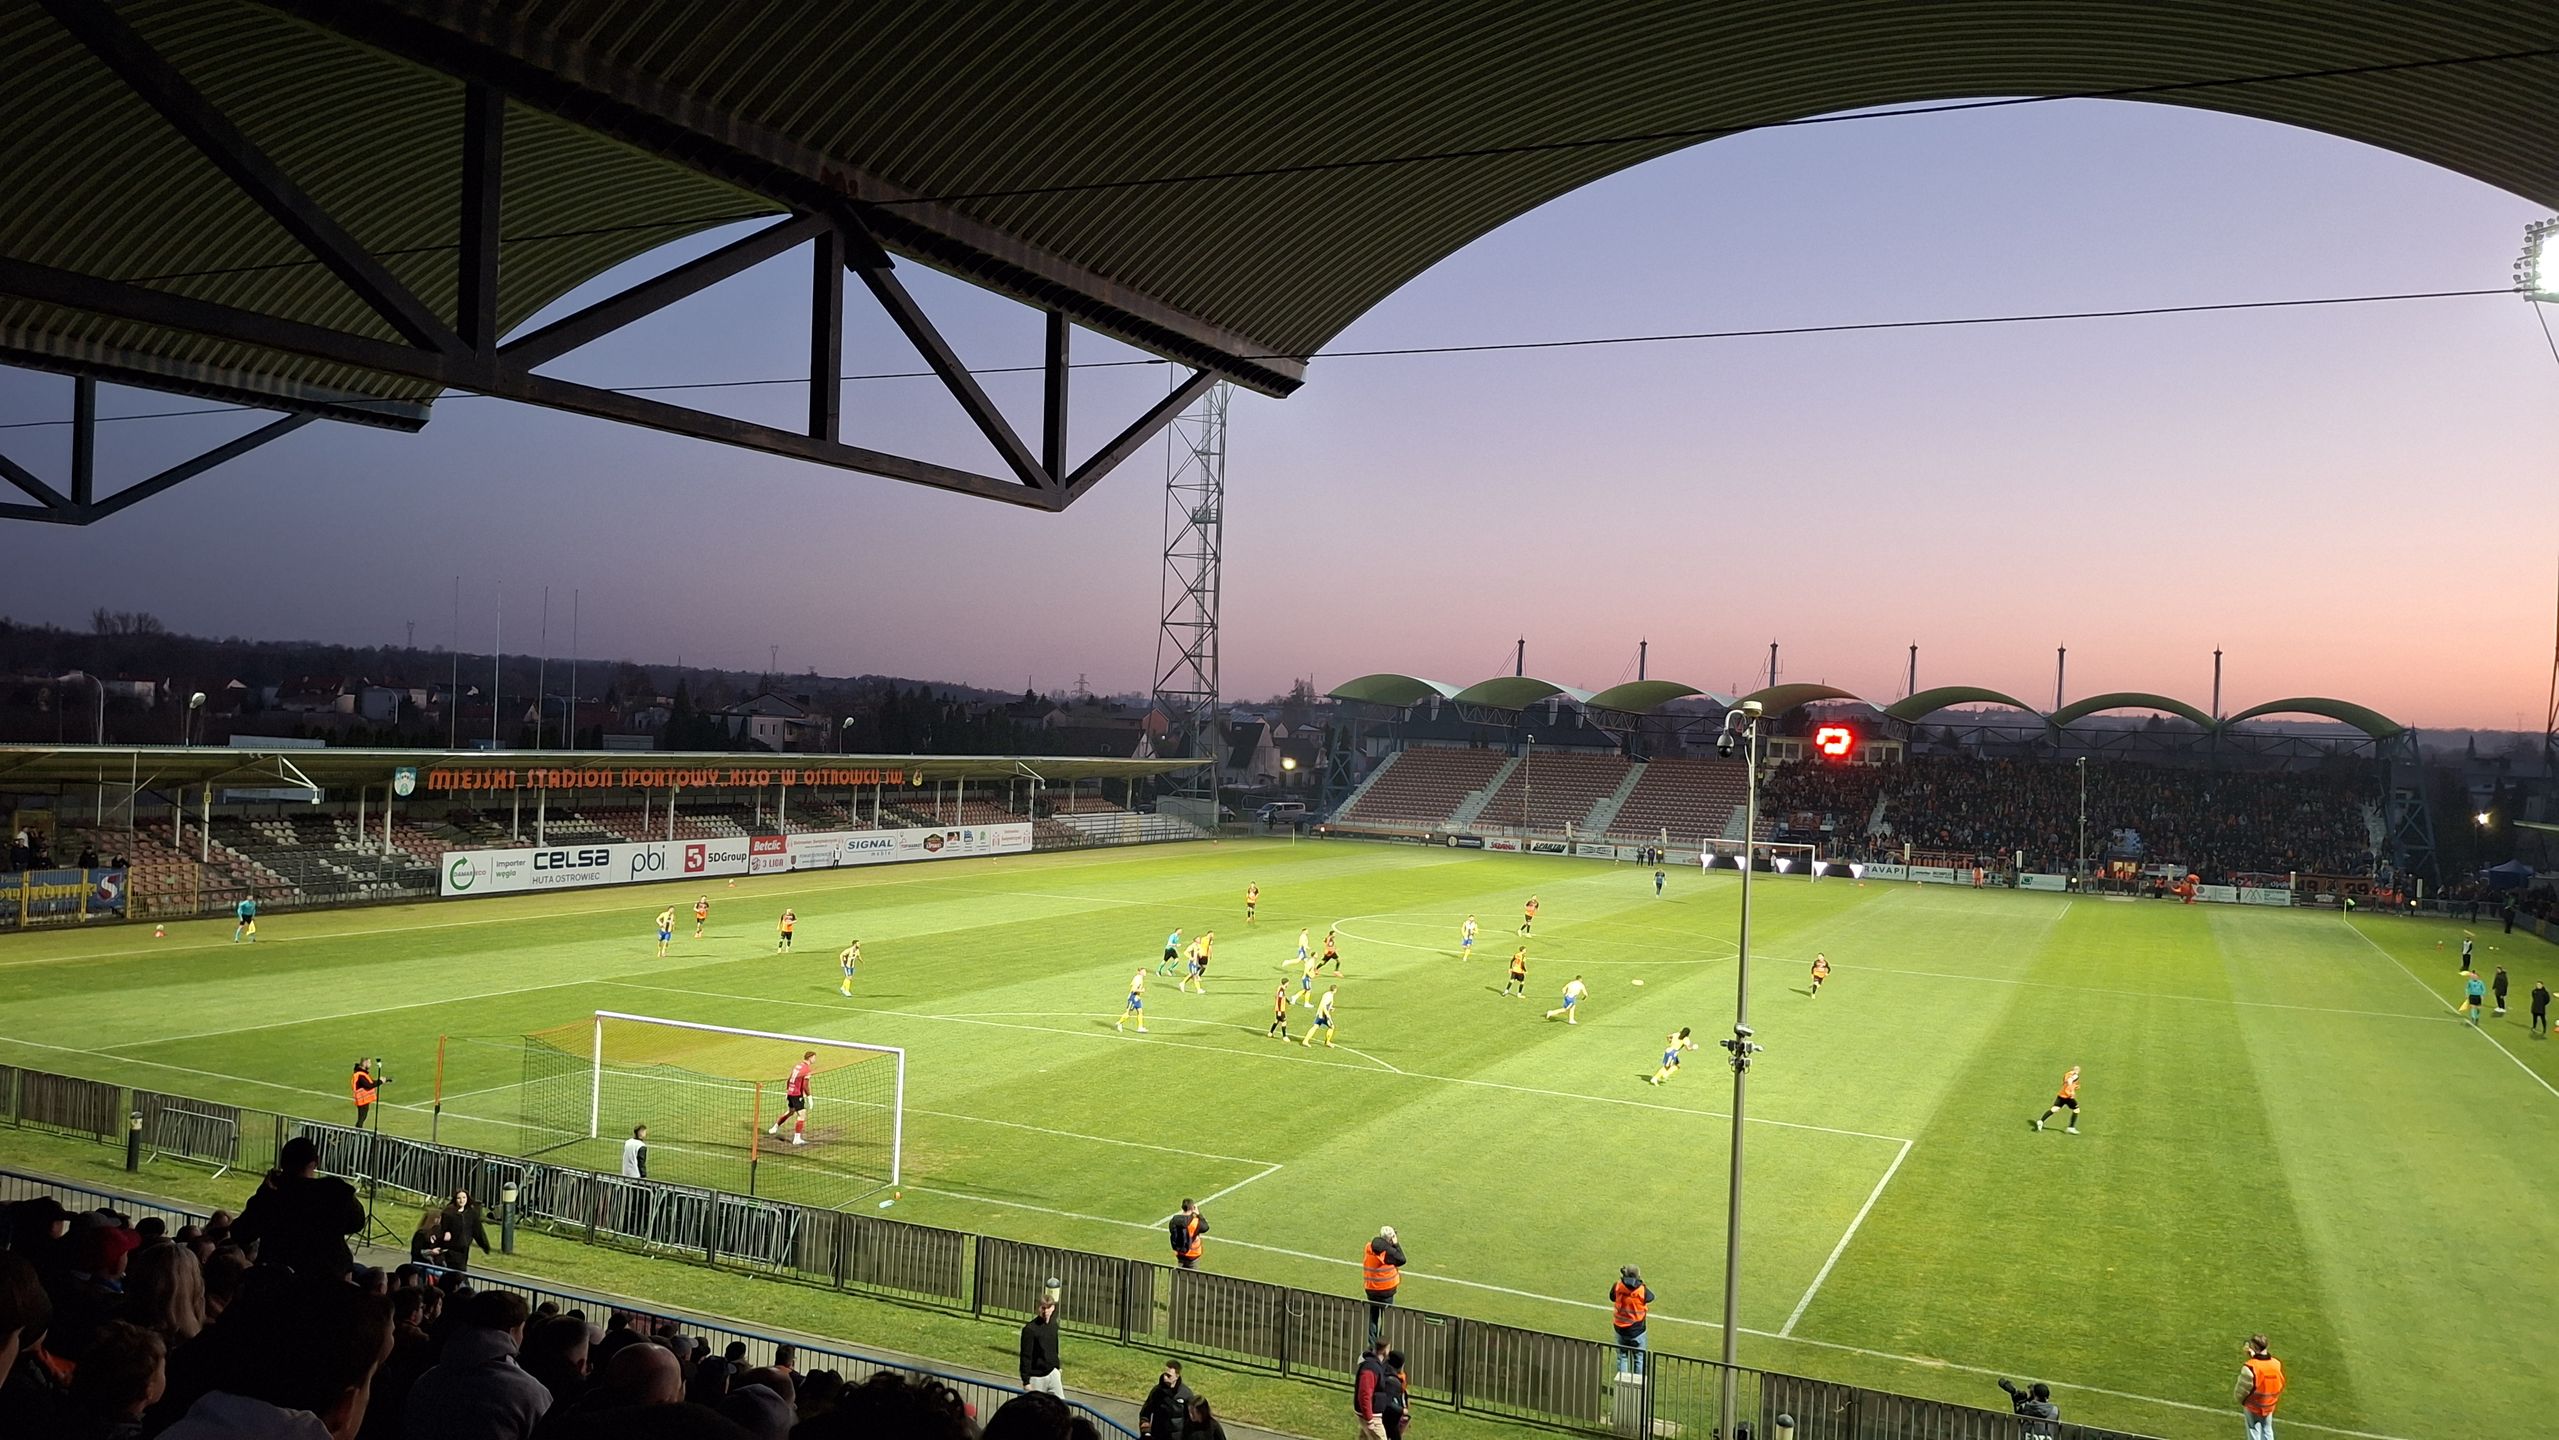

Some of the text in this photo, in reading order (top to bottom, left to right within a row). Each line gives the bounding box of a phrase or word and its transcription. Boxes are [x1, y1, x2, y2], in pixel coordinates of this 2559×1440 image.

[427, 768, 516, 790] MIEJSKI
[527, 768, 614, 789] STADION
[621, 768, 719, 788] SPORTOWY
[781, 769, 796, 786] W
[804, 768, 880, 786] OSTROWCU
[753, 840, 782, 852] Betclic
[847, 839, 894, 850] SIGNAL
[1535, 842, 1567, 851] SPARTAN
[630, 844, 665, 881] pbi
[708, 851, 747, 864] 5DGroup
[762, 857, 784, 868] 3 LIGA
[532, 872, 600, 885] HUTA OSTROWIEC
